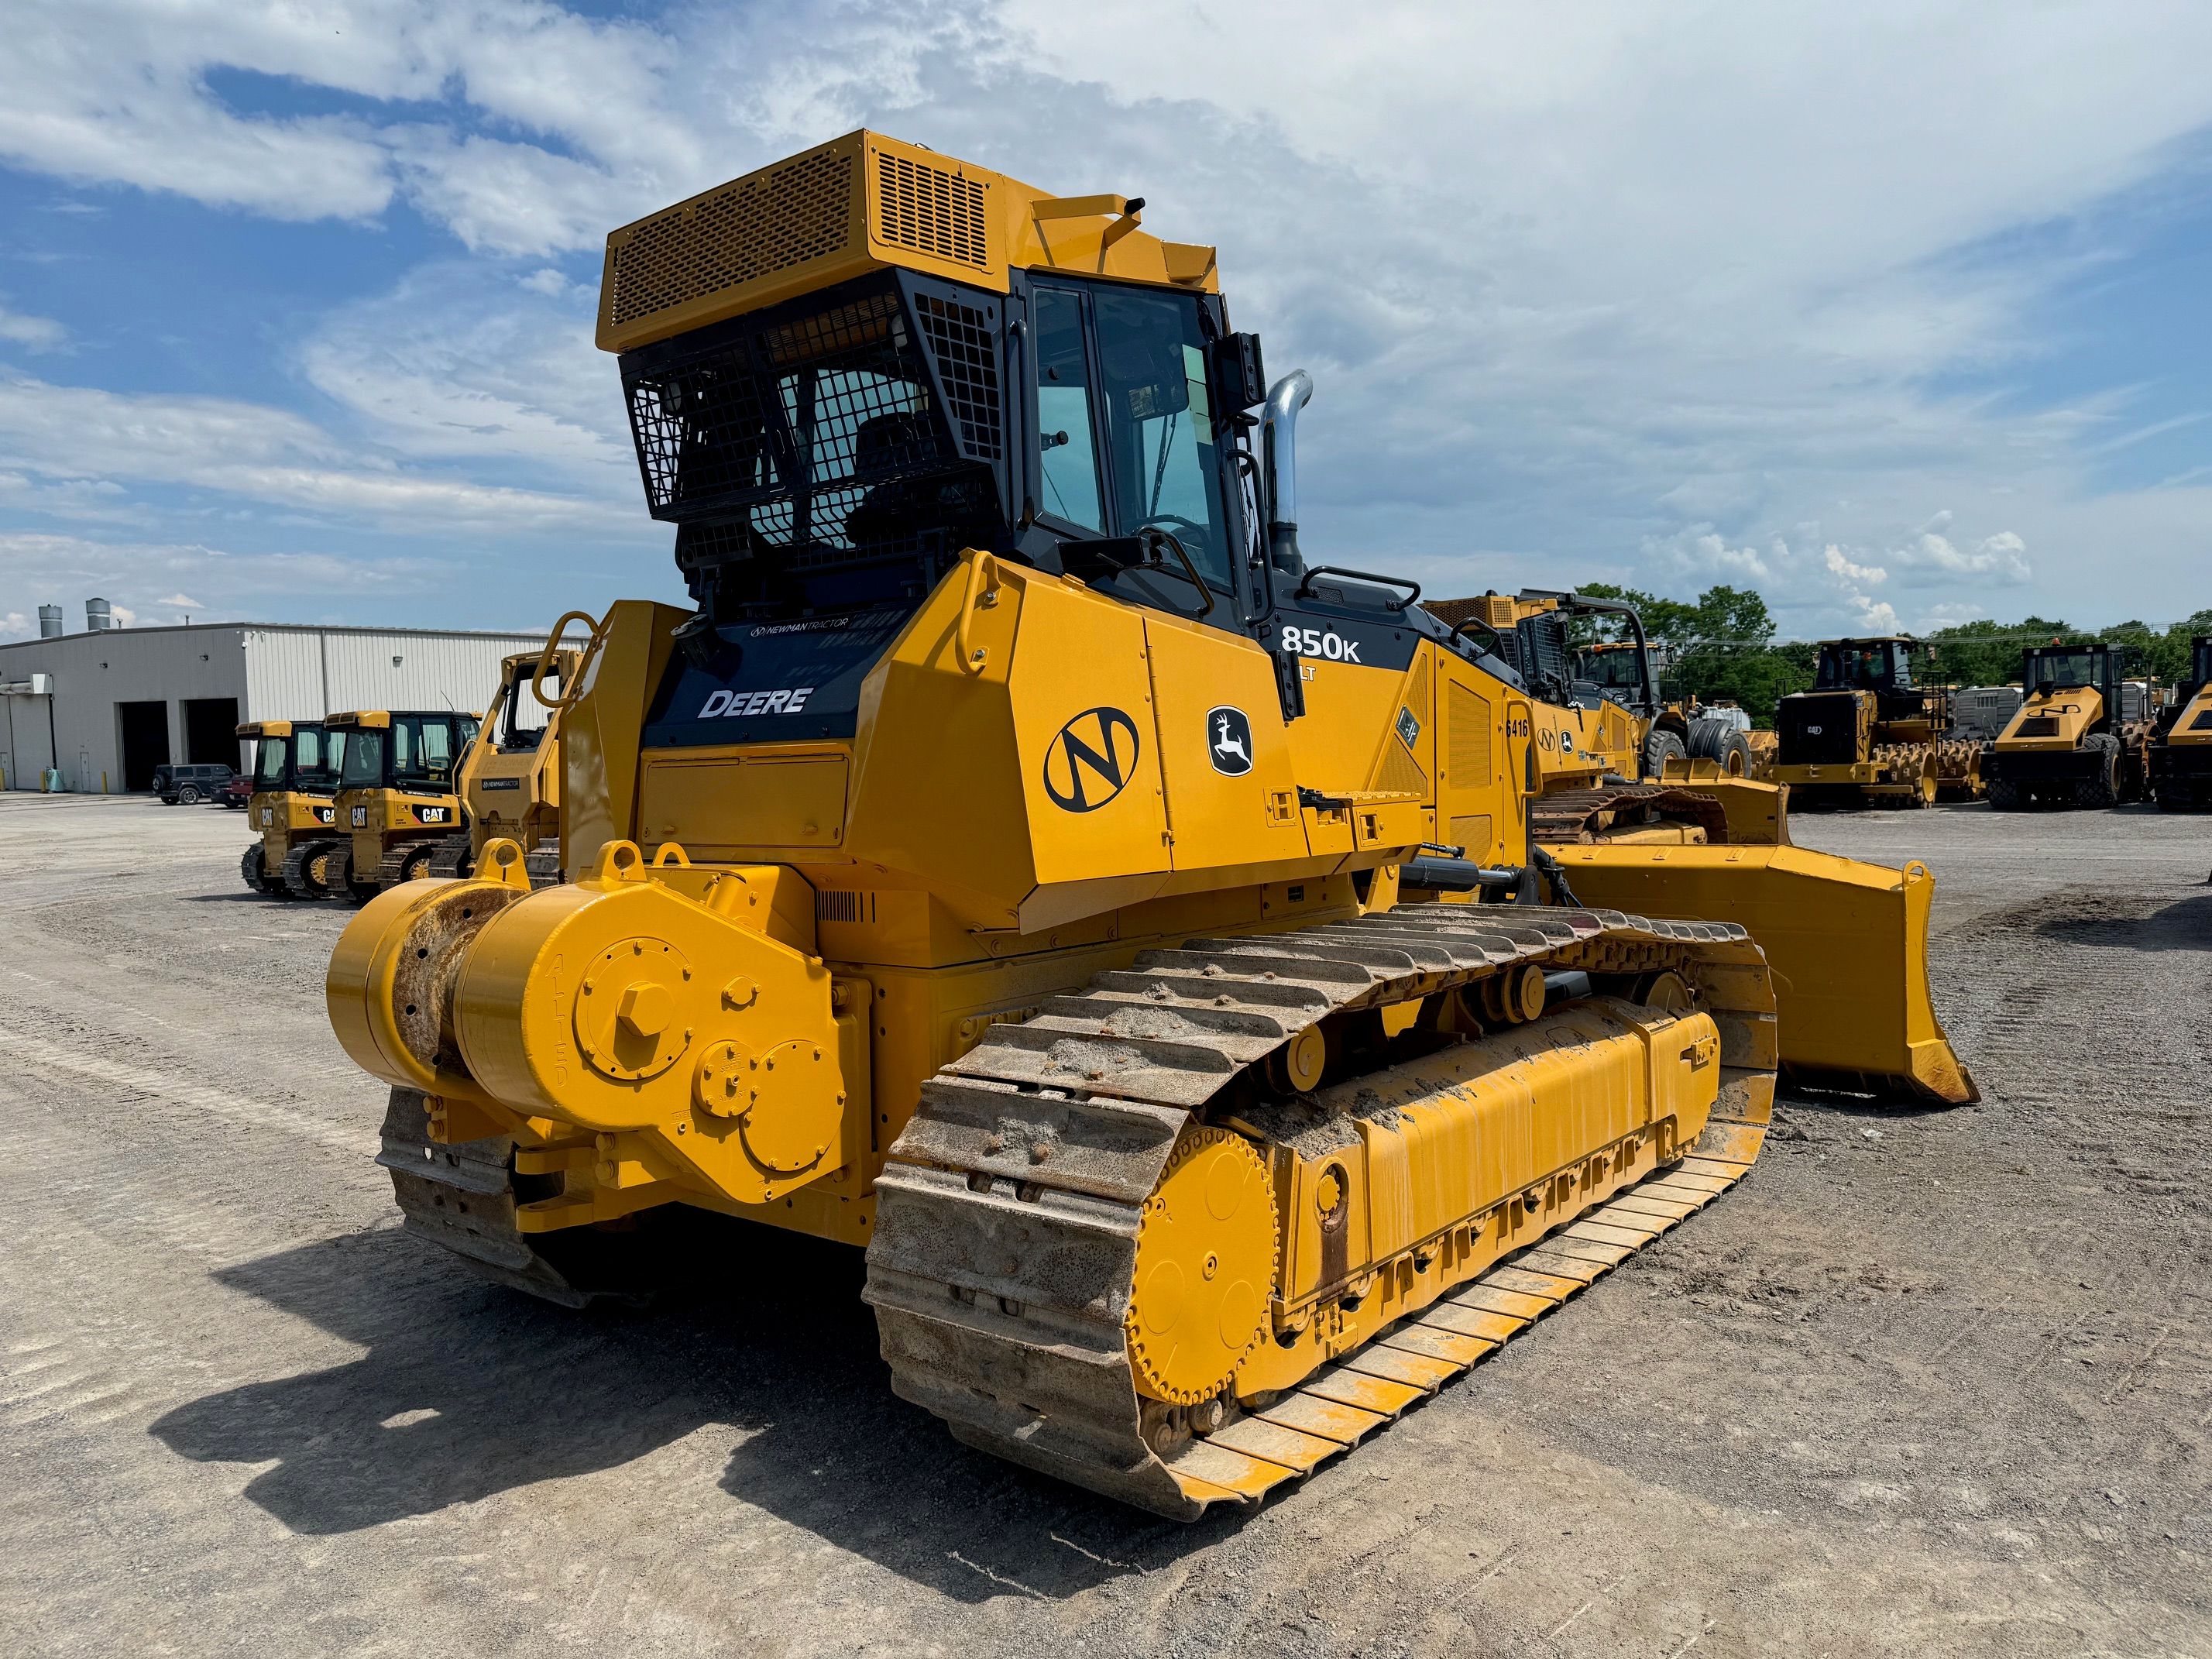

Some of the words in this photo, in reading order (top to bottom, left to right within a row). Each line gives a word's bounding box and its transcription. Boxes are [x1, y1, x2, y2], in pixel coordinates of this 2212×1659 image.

[1282, 626, 1362, 664] 850K
[697, 687, 814, 718] DEERE
[1506, 719, 1528, 738] 6416
[261, 808, 273, 826] CAT
[352, 807, 366, 826] CAT
[422, 808, 445, 823] CAT
[545, 953, 568, 1088] ALLIED
